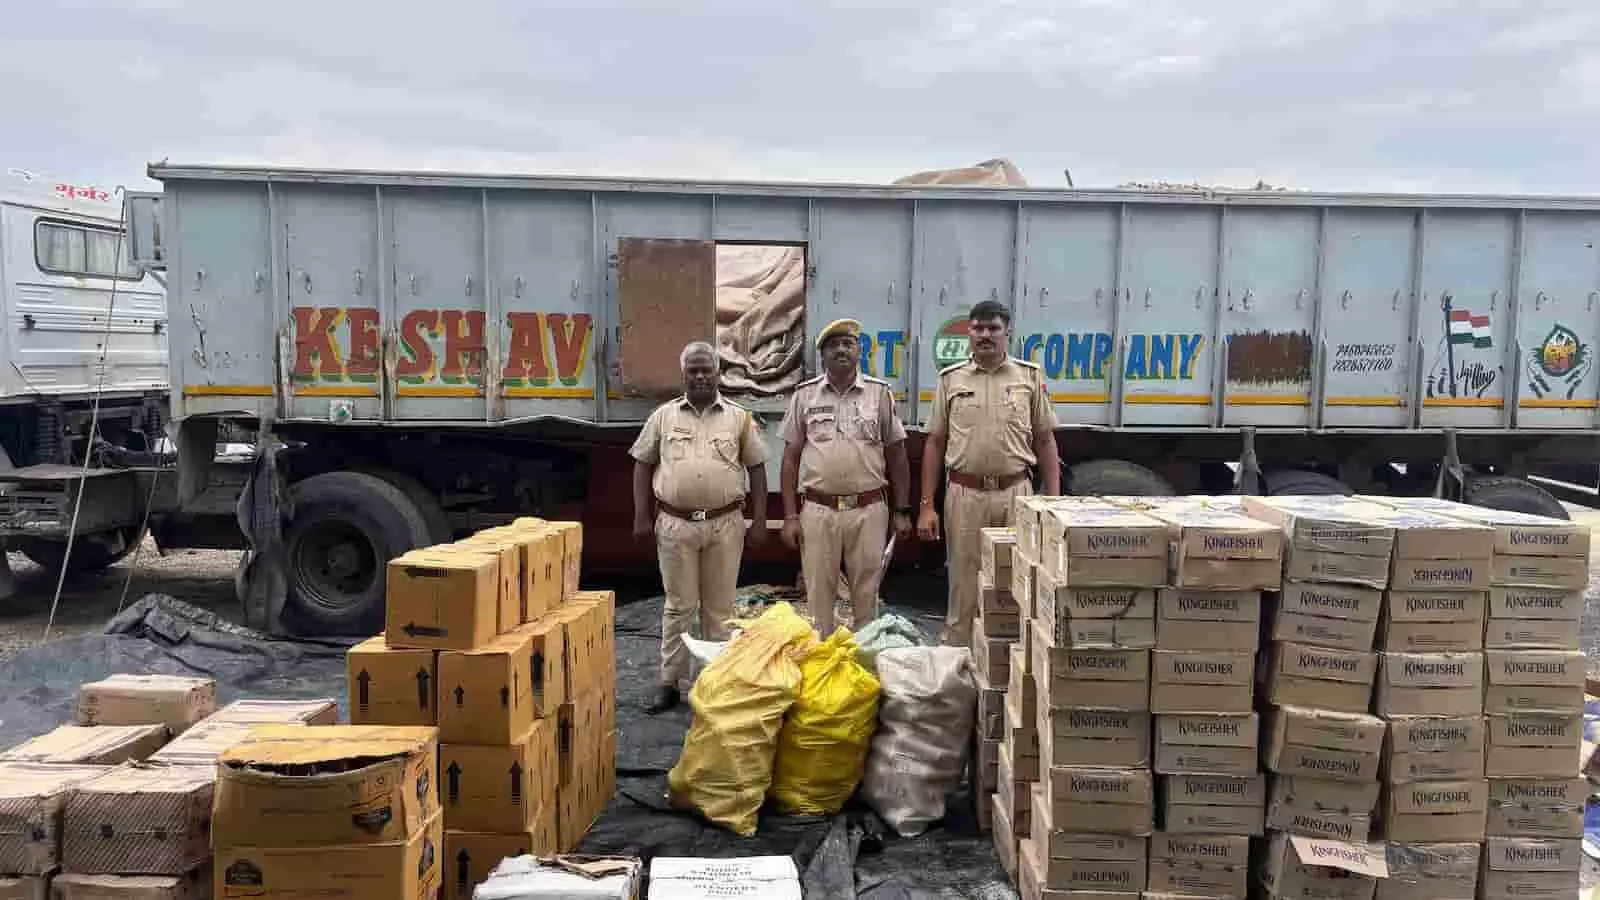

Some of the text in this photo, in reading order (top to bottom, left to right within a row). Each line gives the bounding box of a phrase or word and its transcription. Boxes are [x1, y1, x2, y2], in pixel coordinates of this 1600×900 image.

[288, 306, 595, 387] KESHAV
[1021, 332, 1203, 381] COMPANY
[1087, 534, 1150, 548] KINGFISHER
[1203, 535, 1264, 551] KINGFISHER
[1510, 530, 1570, 546] KINGFISHER
[1178, 597, 1240, 611] KINGFISHER
[1300, 591, 1359, 611] KINGFISHER
[1406, 597, 1467, 612] KINGFISHER
[1505, 593, 1567, 609] KINGFISHER
[1068, 656, 1129, 670] KINGFISHER
[1174, 661, 1233, 675] KINGFISHER
[1298, 654, 1360, 672] KINGFISHER
[1404, 661, 1467, 677] KINGFISHER
[1504, 661, 1568, 675] KINGFISHER
[1178, 719, 1242, 736] KINGFISHER
[1408, 726, 1468, 742] KINGFISHER
[1507, 720, 1567, 737] KINGFISHER
[1185, 780, 1248, 796] KINGFISHER
[1506, 784, 1568, 798] KINGFISHER
[1412, 790, 1472, 805] KINGFISHER
[1168, 840, 1232, 857] KINGFISHER
[1310, 844, 1369, 867] KINGFISHER
